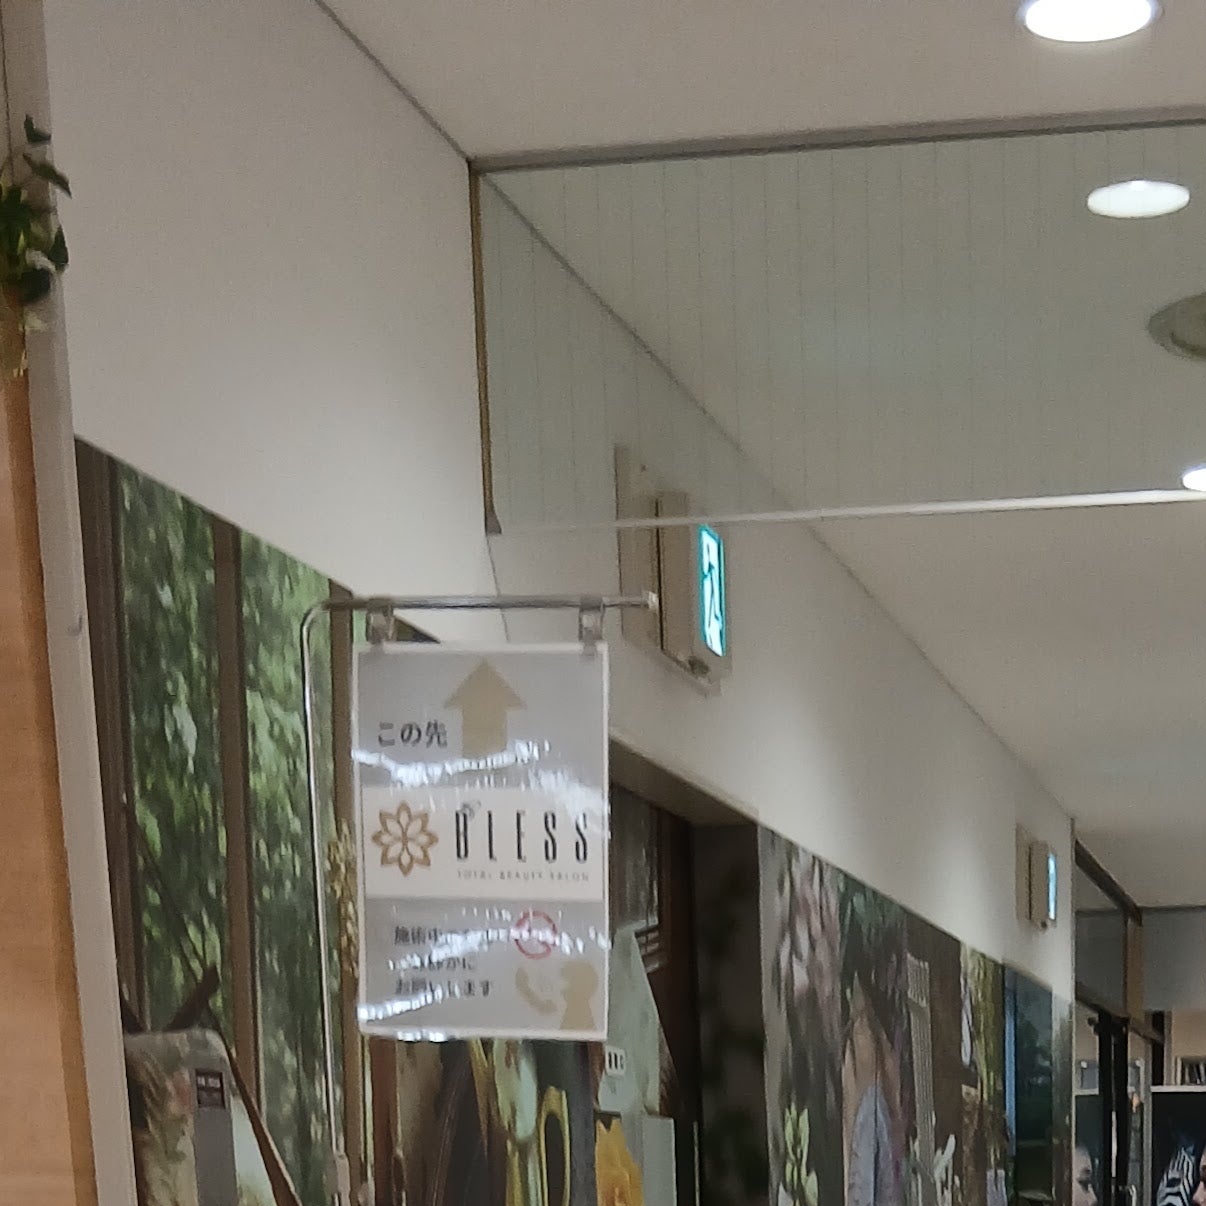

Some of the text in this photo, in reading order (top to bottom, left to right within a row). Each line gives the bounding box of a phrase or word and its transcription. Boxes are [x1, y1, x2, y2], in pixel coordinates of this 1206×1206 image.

[378, 719, 448, 748] この先
[455, 809, 588, 863] BLESS
